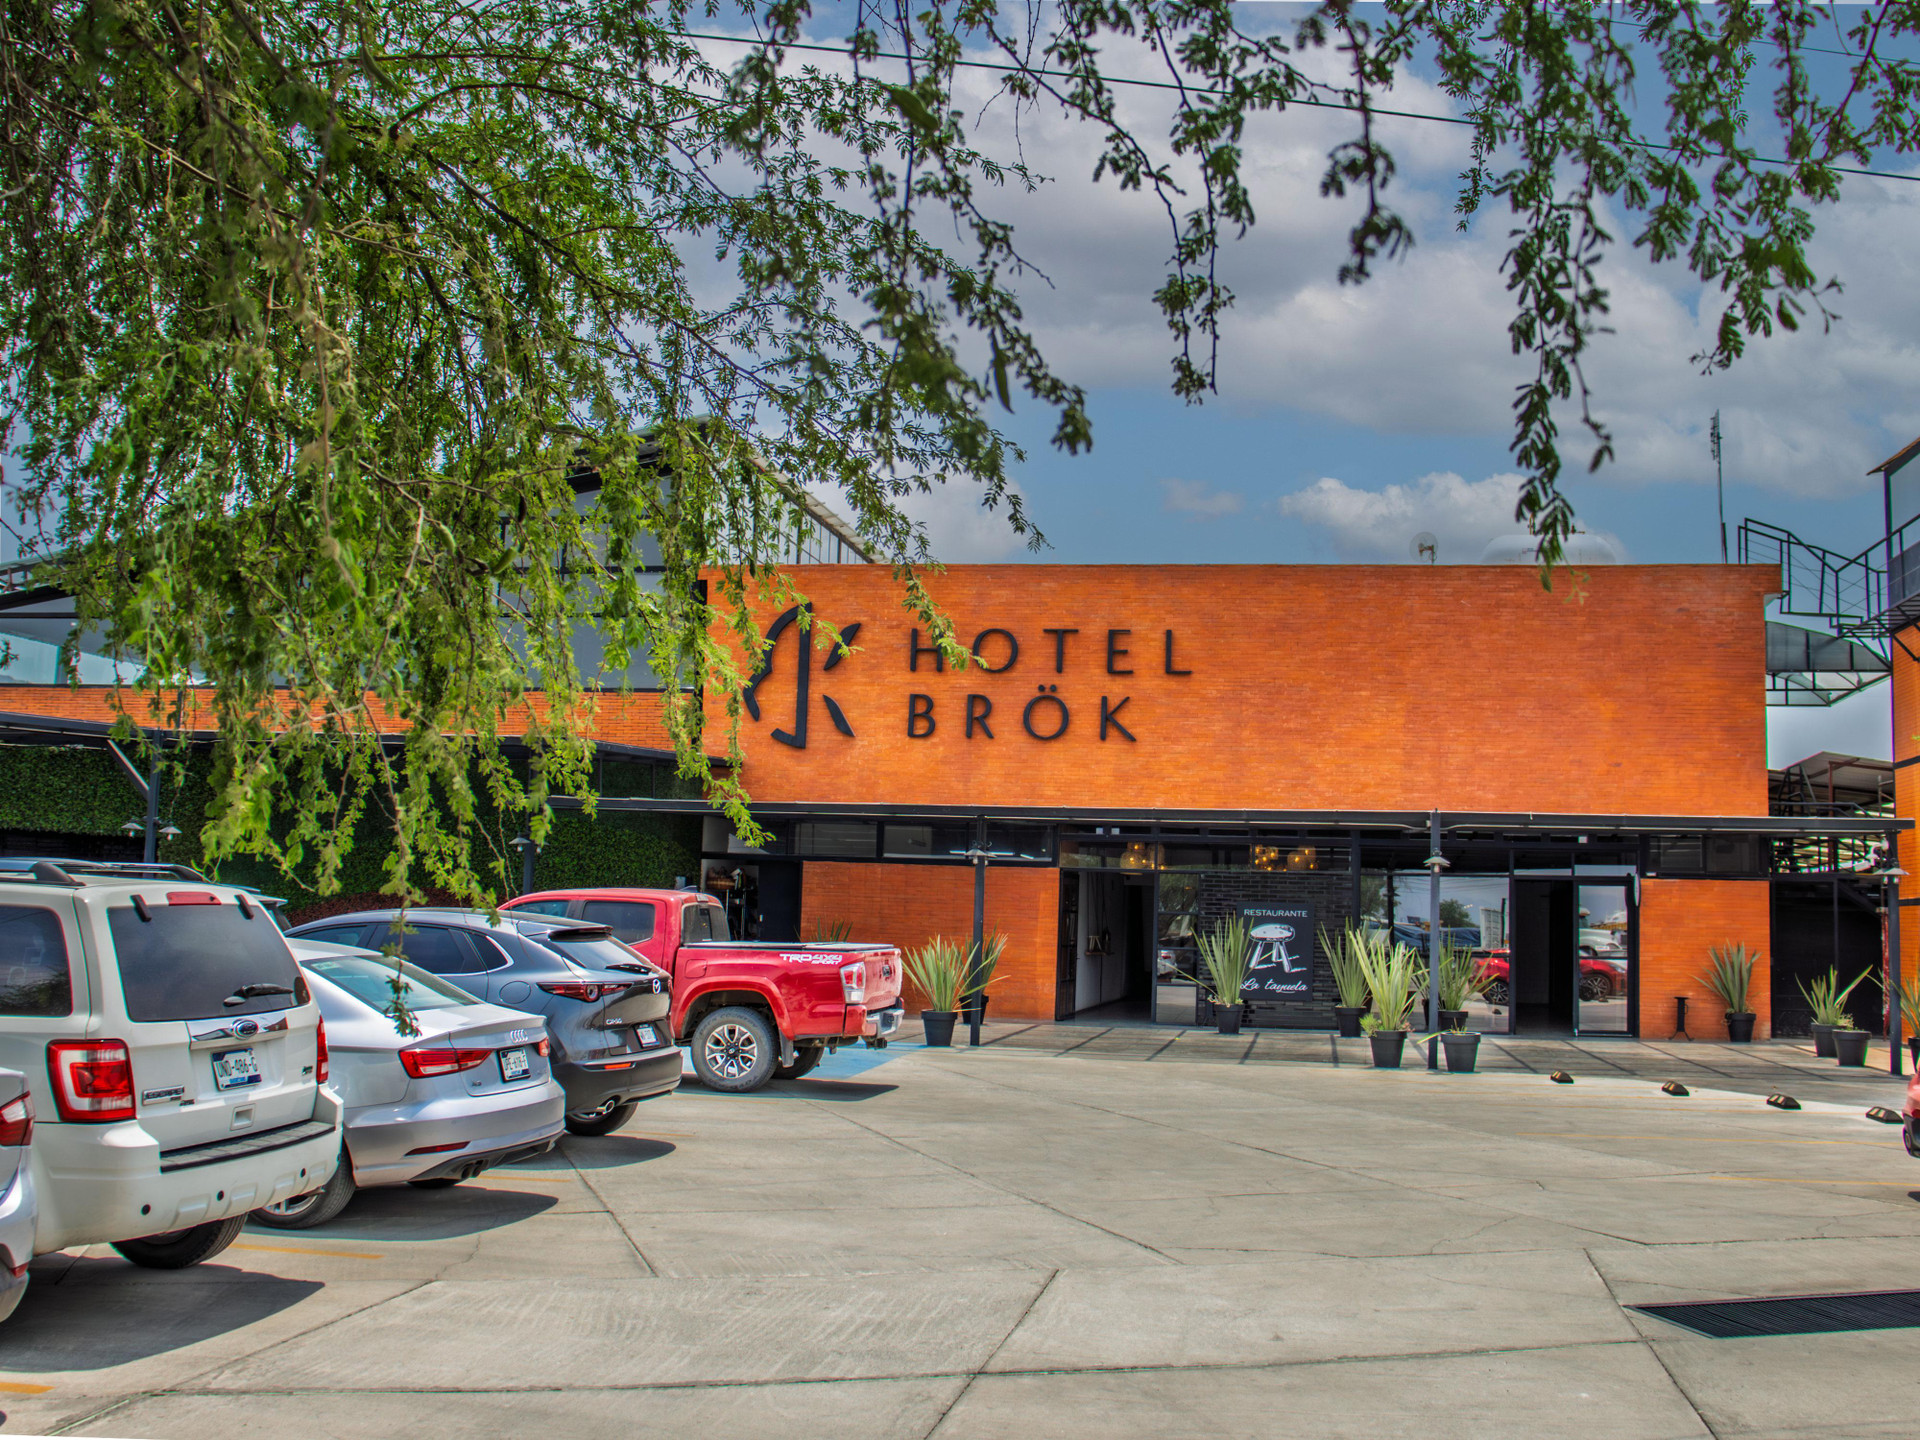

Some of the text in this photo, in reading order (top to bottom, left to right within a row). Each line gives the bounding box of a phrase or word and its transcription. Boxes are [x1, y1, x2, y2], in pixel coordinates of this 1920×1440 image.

[910, 628, 1193, 675] HOTEL
[907, 684, 1137, 742] BRÖK
[1243, 909, 1308, 918] RESTAURANTE
[779, 953, 812, 963] TRD
[1240, 978, 1260, 991] La
